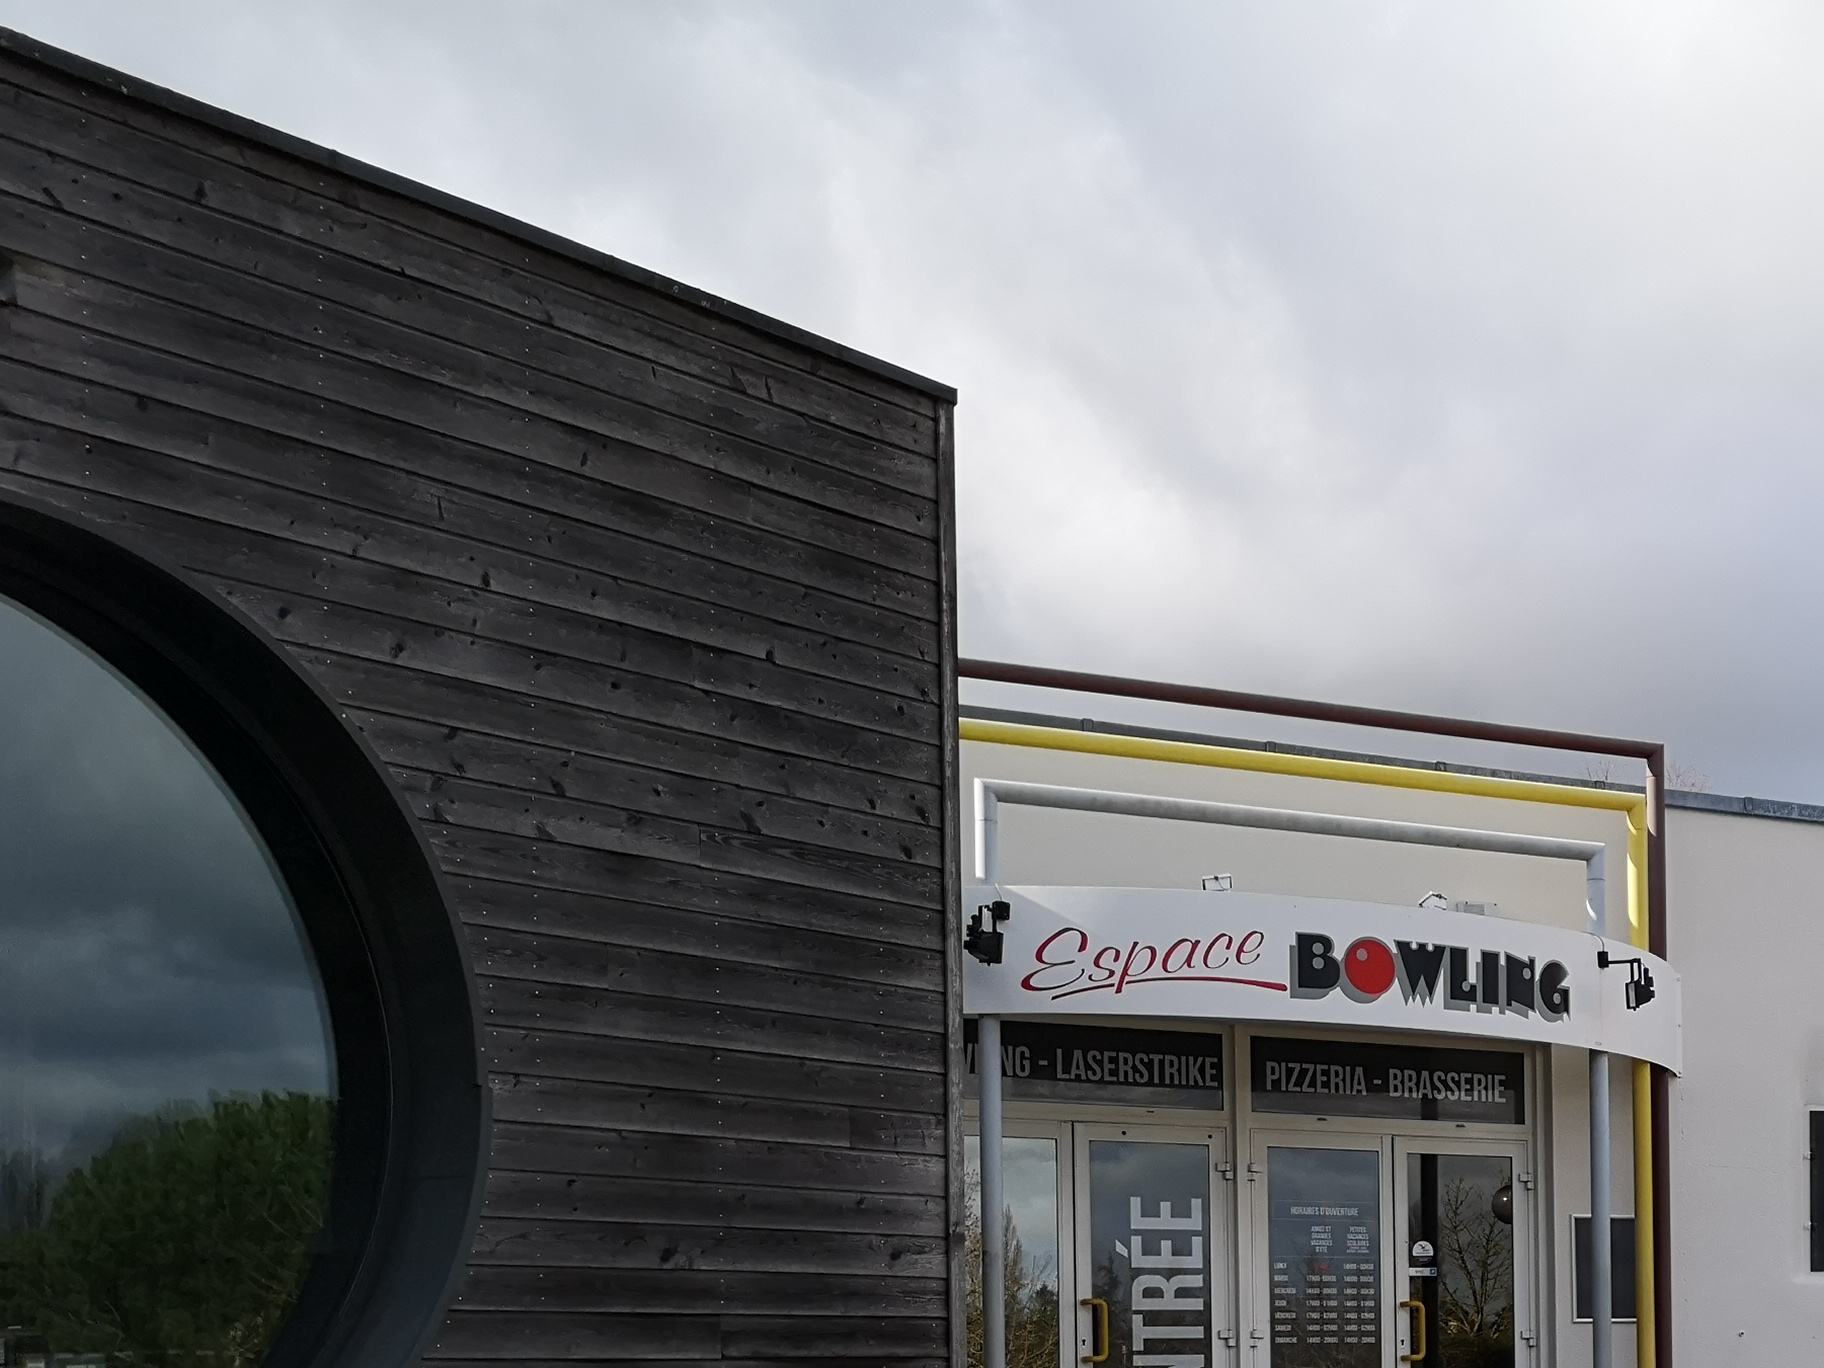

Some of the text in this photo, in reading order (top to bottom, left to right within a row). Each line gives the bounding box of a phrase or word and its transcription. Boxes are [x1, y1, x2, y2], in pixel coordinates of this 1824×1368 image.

[1021, 927, 1572, 1022] Espace BOWLING
[1056, 1048, 1219, 1087] LASERSTRIKE
[1266, 1061, 1367, 1096] PIZZERIA
[1389, 1068, 1507, 1103] BRASSERIE
